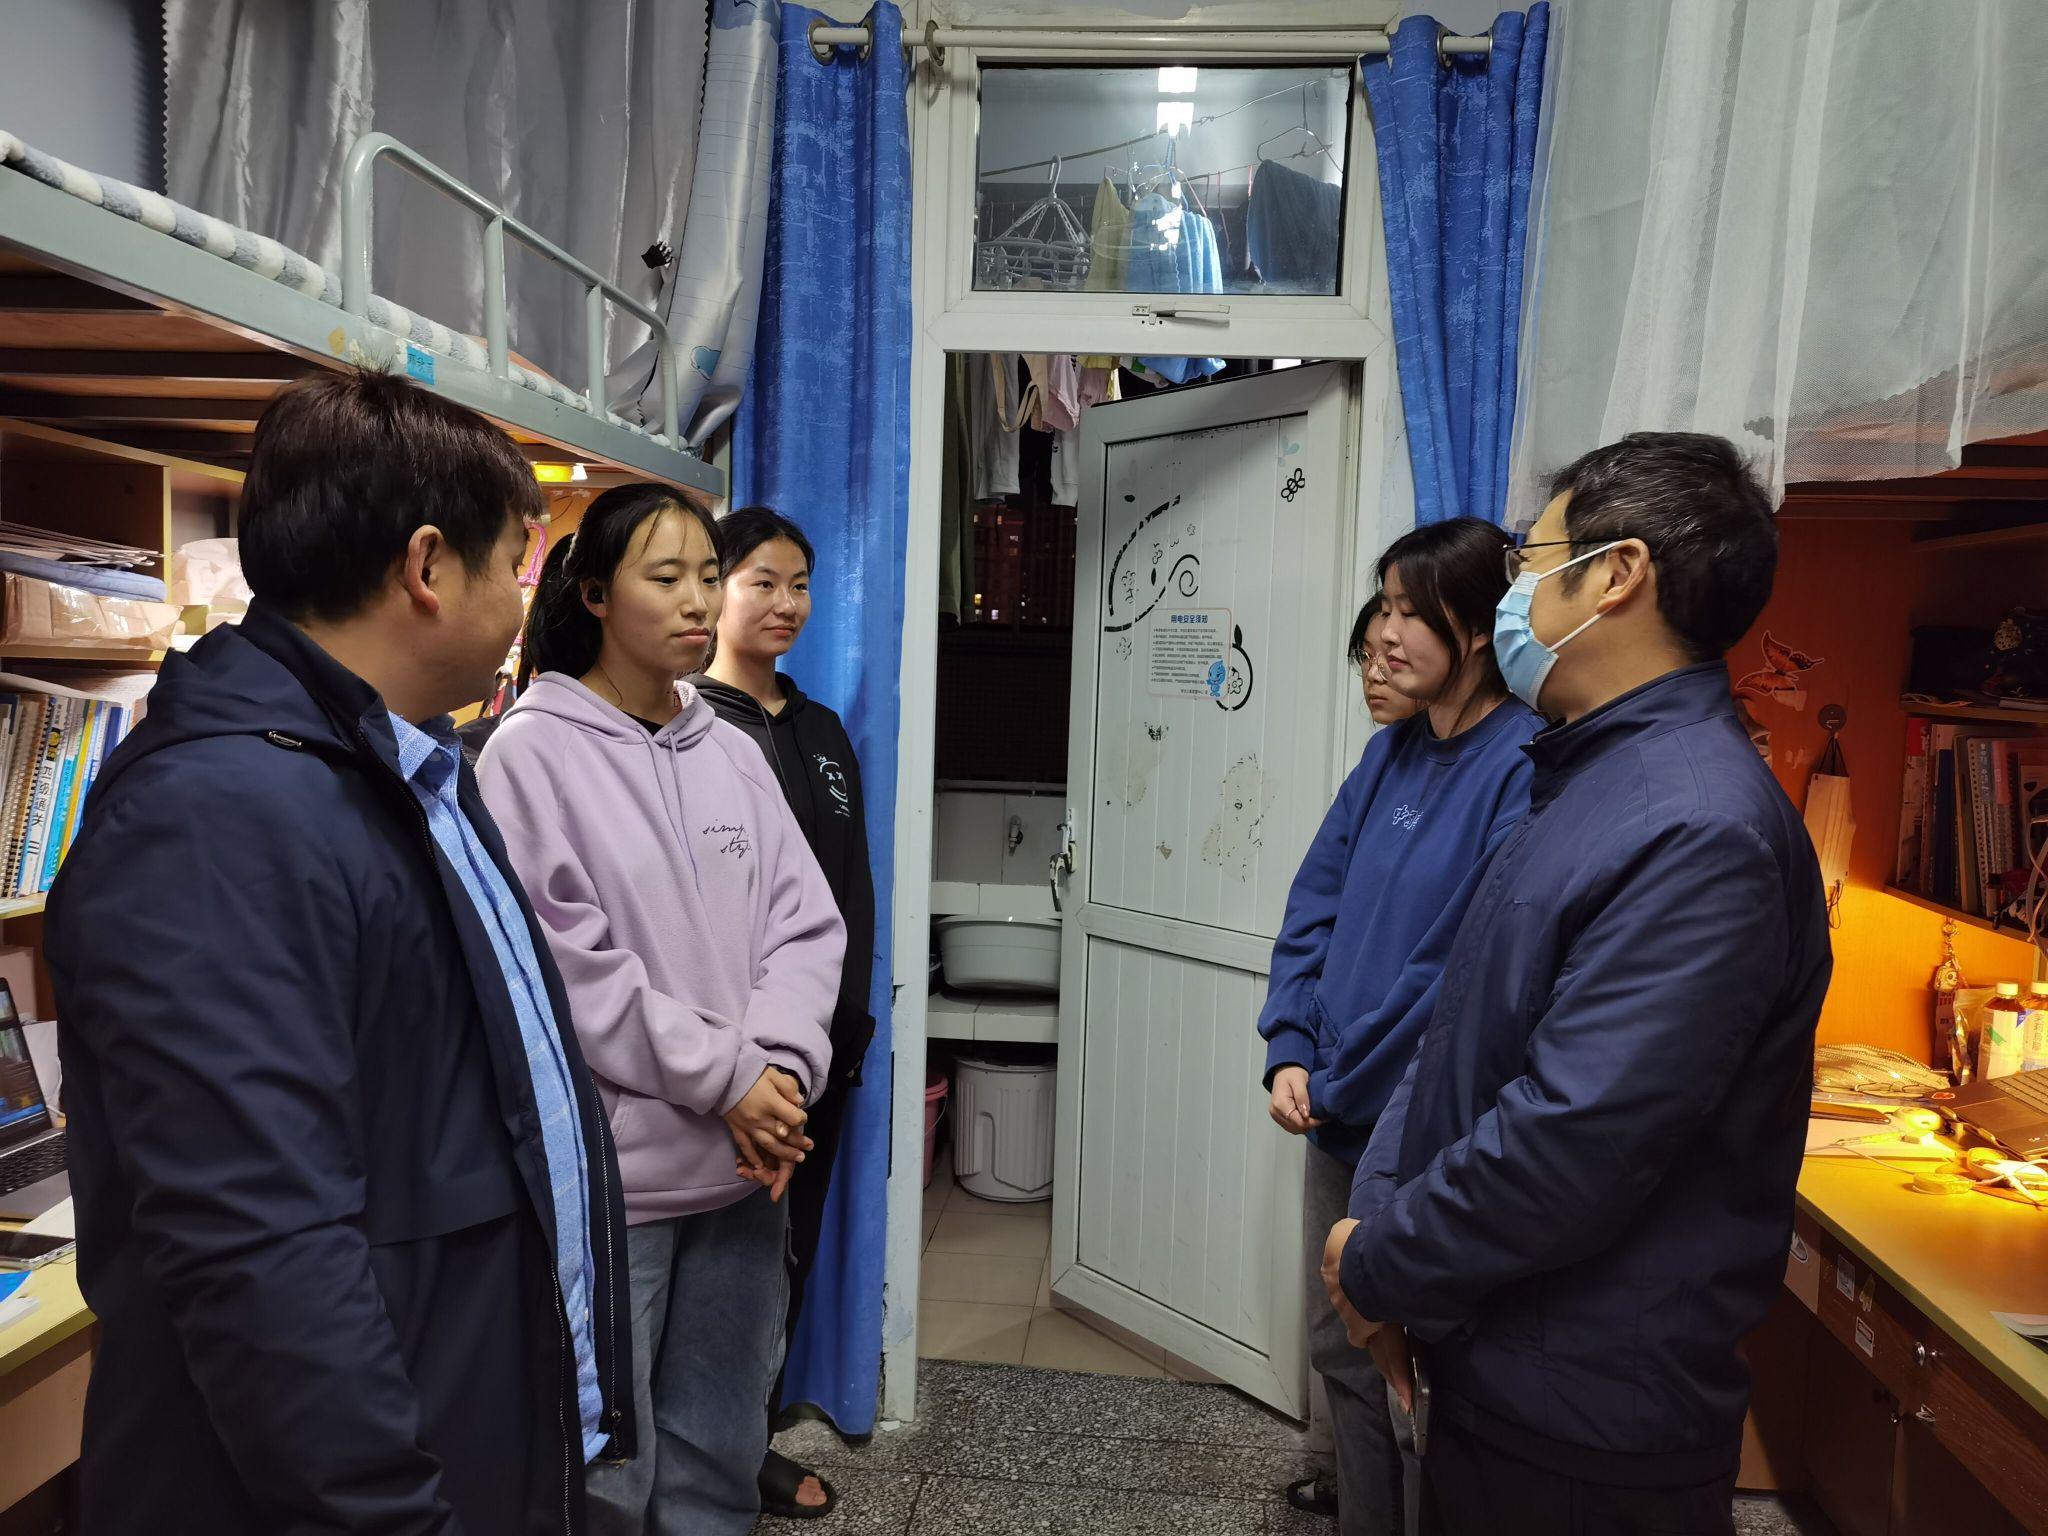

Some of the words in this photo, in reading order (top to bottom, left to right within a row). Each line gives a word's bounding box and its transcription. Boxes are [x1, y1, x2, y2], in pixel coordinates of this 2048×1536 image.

[1170, 614, 1208, 624] 用电安全须知
[702, 818, 749, 840] simp
[720, 836, 752, 859] sty
